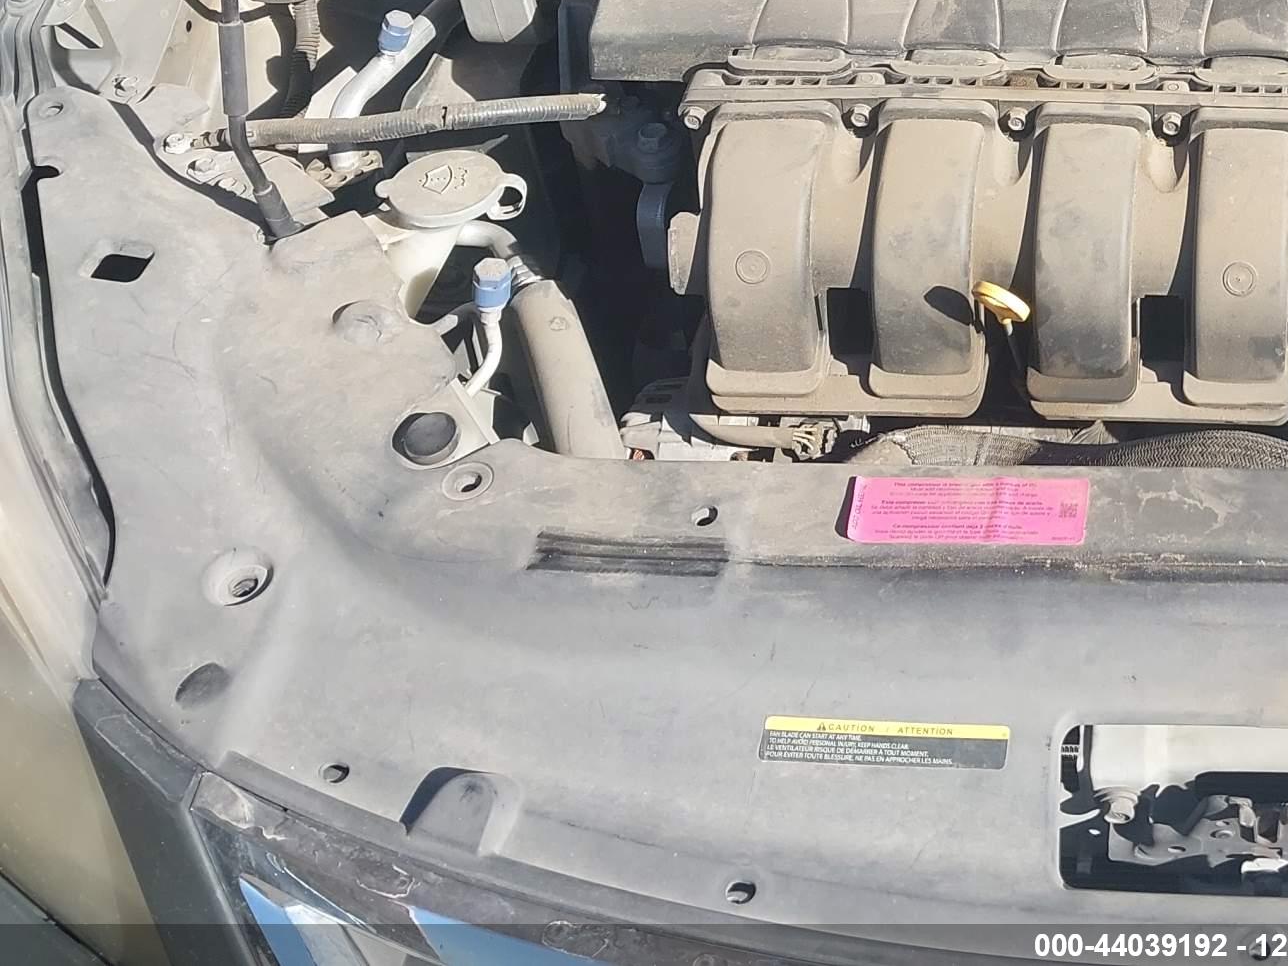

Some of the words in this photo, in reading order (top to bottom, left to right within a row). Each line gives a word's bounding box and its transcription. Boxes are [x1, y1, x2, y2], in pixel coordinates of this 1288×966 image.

[828, 724, 875, 732] CAUTION
[897, 726, 953, 736] ATTENTION
[774, 744, 813, 752] VENTILATEUR
[885, 756, 921, 764] APPROCHER
